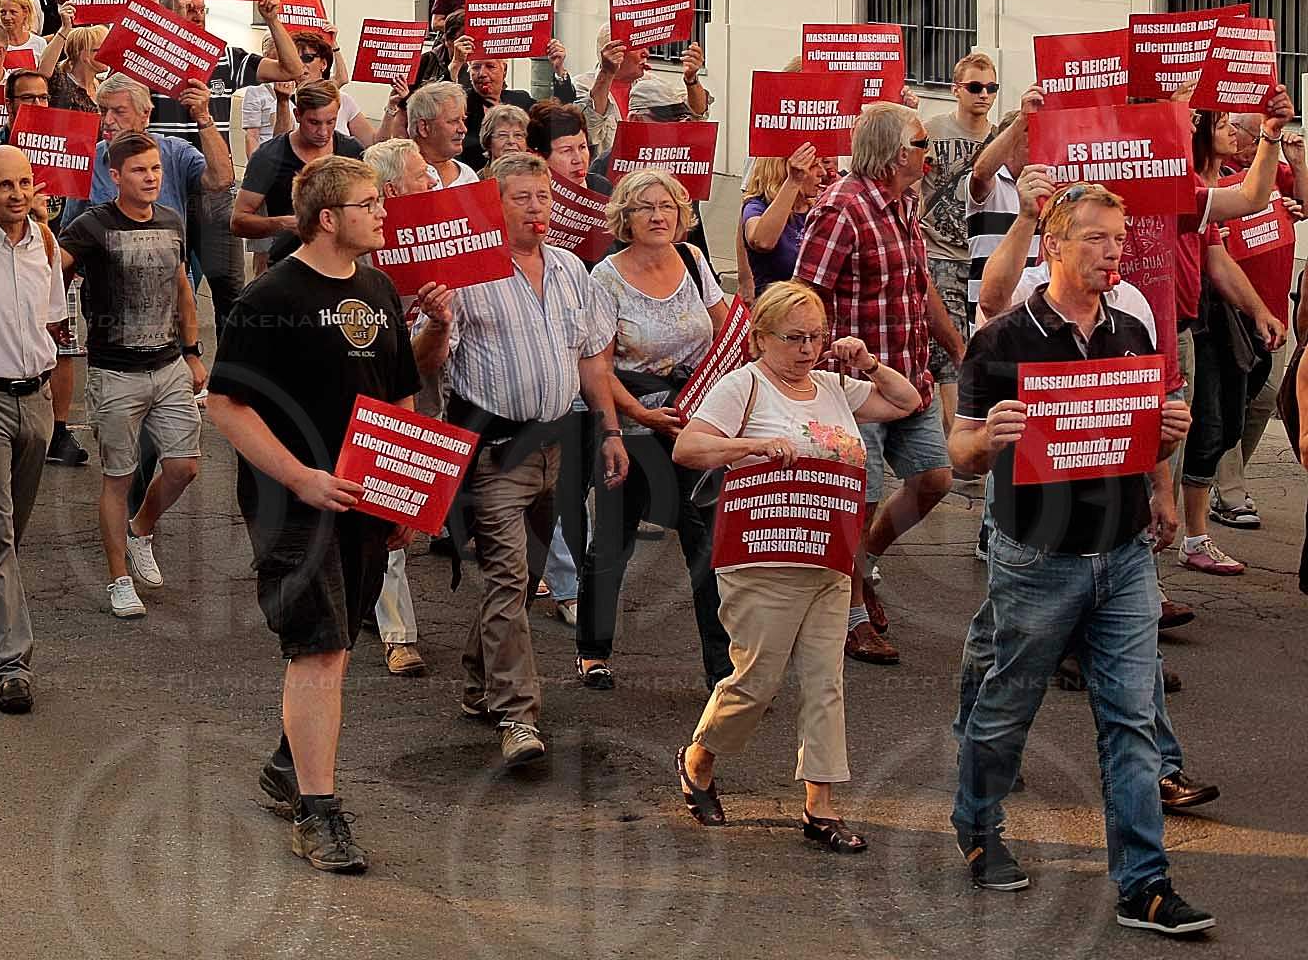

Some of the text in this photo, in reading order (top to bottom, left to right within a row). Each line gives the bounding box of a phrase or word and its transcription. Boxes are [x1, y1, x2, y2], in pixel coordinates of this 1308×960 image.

[468, 2, 514, 11] MASSENLAGER
[128, 2, 221, 57] MASSENLAGER ABSCHAFFEN
[470, 16, 510, 26] FLÜCHTLINGE
[1134, 21, 1196, 34] MASSENLAGER
[806, 34, 899, 43] MASSENLAGER ABSCHAFFEN
[1216, 27, 1258, 40] MASSENLAGER
[121, 17, 211, 72] FLÜCHTLINGE MENSCHLICH
[135, 37, 190, 72] UNTERBRINGEN
[808, 50, 854, 60] FLÜCHTLINGE
[1136, 42, 1193, 53] FLÜCHTLINGE
[122, 59, 175, 90] TRAISKIRCHEN
[123, 49, 182, 85] SOLIDARITÄT MIT
[828, 62, 882, 71] UNTERBRINGEN
[1065, 57, 1121, 75] ES REICHT,
[1042, 78, 1073, 94] FRAU
[780, 100, 838, 115] ES REICHT,
[755, 114, 787, 129] FRAU
[26, 132, 66, 153] REICHT,
[1067, 139, 1154, 162] ES REICHT,
[638, 147, 690, 160] ES REICHT,
[1083, 159, 1187, 181] MINISTERIN!
[396, 217, 472, 245] ES REICHT,
[376, 230, 503, 267] FRAU MINISTERIN!
[318, 308, 388, 329] Hard Rock
[679, 353, 717, 410] MASSENLAGER
[1024, 368, 1161, 390] MASSENLAGER ABSCHAFFEN
[1026, 396, 1159, 417] FLÜCHTLINGE MENSCHLICH
[1055, 412, 1132, 430] UNTERBRINGEN
[356, 408, 471, 456] MASSENLAGER ABSCHAFFEN
[352, 432, 460, 478] FLÜCHTLINGE MENSCHLICH
[1046, 438, 1132, 457] SOLIDARITÄT MIT
[375, 455, 436, 486] UNTERBRINGEN
[1052, 452, 1125, 470] TRAISKIRCHEN
[362, 475, 429, 506] SOLIDARITÄT MIT
[725, 470, 862, 492] MASSENLAGER ABSCHAFFEN
[361, 489, 420, 518] TRAISKIRCHEN
[724, 493, 858, 514] FLÜCHTLINGE MENSCHLICH
[750, 506, 830, 522] UNTERBRINGEN
[742, 528, 831, 544] SOLIDARITÄT MIT
[747, 541, 826, 556] TRAISKIRCHEN
